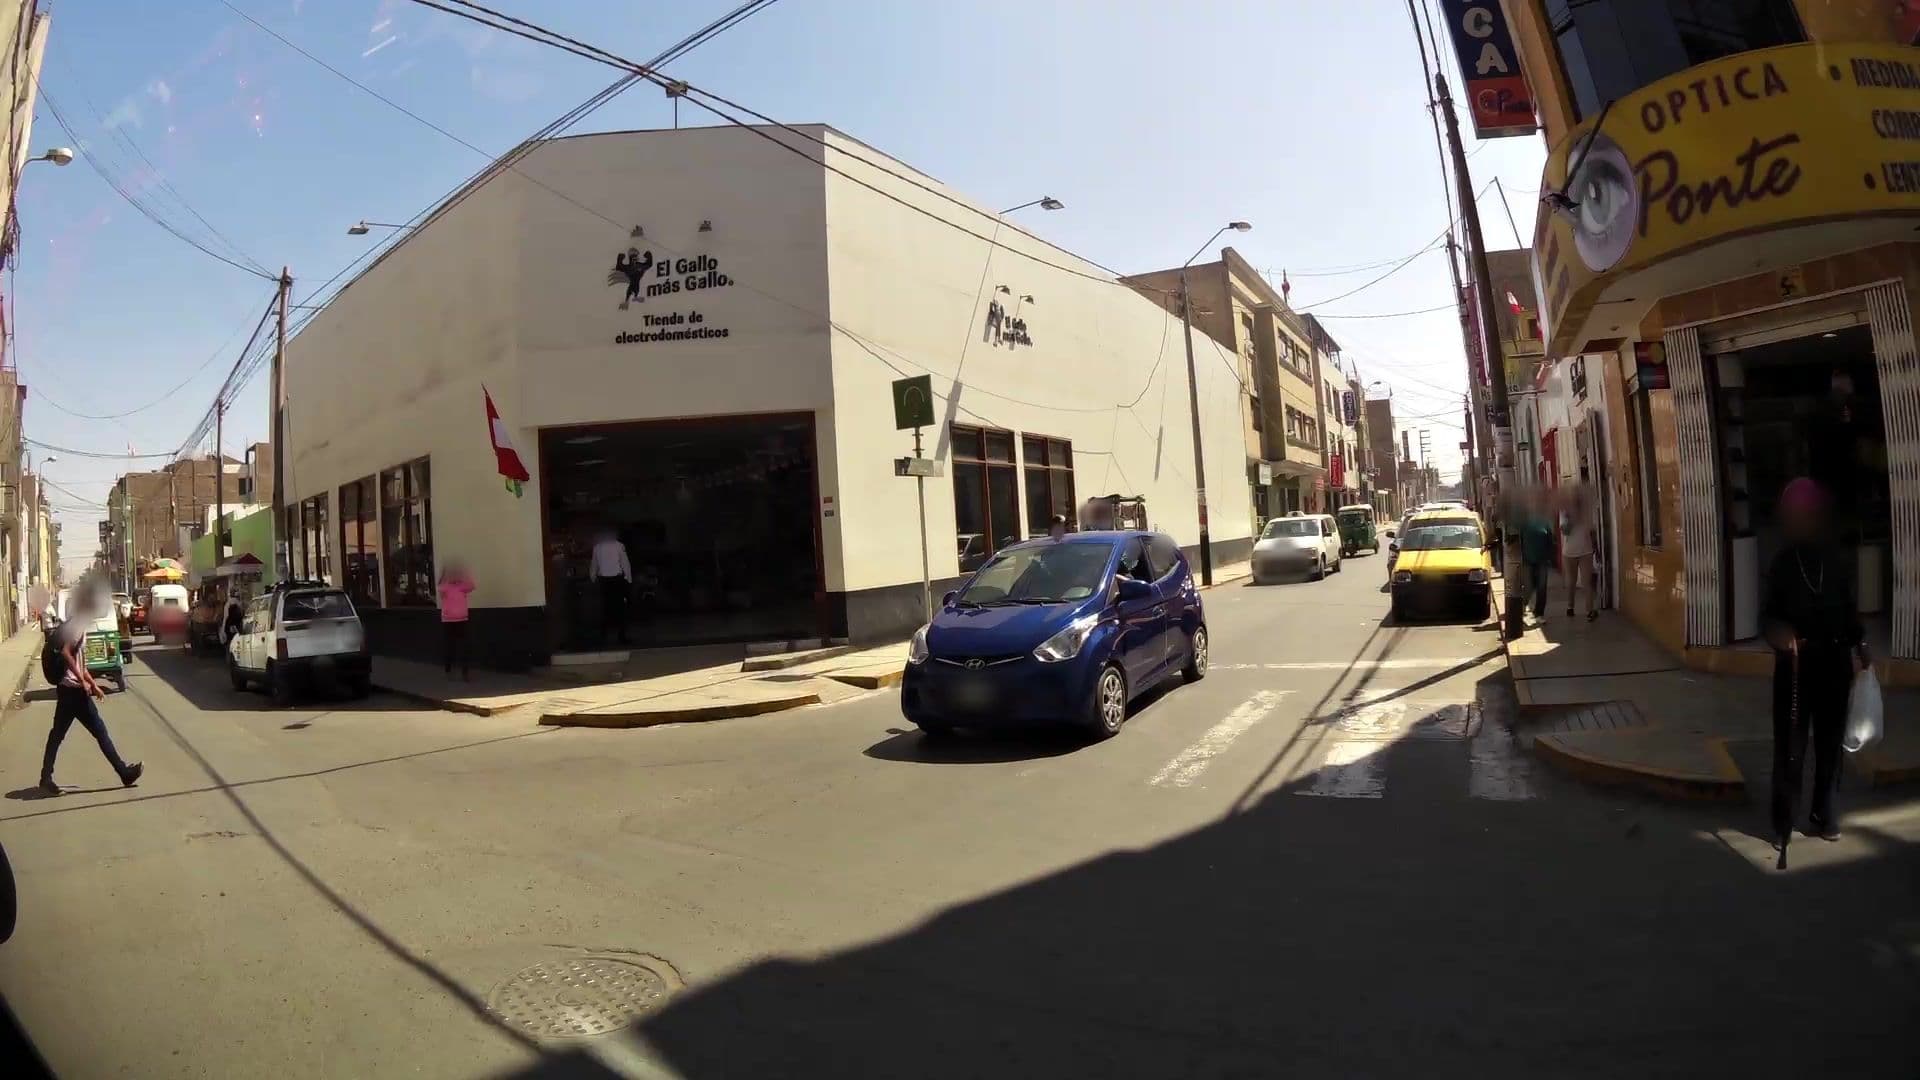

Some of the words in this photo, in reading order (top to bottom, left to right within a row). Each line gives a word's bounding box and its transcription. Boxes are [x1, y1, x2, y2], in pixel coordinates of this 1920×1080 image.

[1641, 62, 1788, 133] OPTICA
[1633, 133, 1801, 238] Ponte
[656, 260, 671, 278] El
[676, 255, 718, 275] Gallo
[647, 279, 681, 297] más
[643, 312, 684, 327] Tienda
[689, 311, 703, 324] de
[615, 327, 729, 344] electrodomésticos
